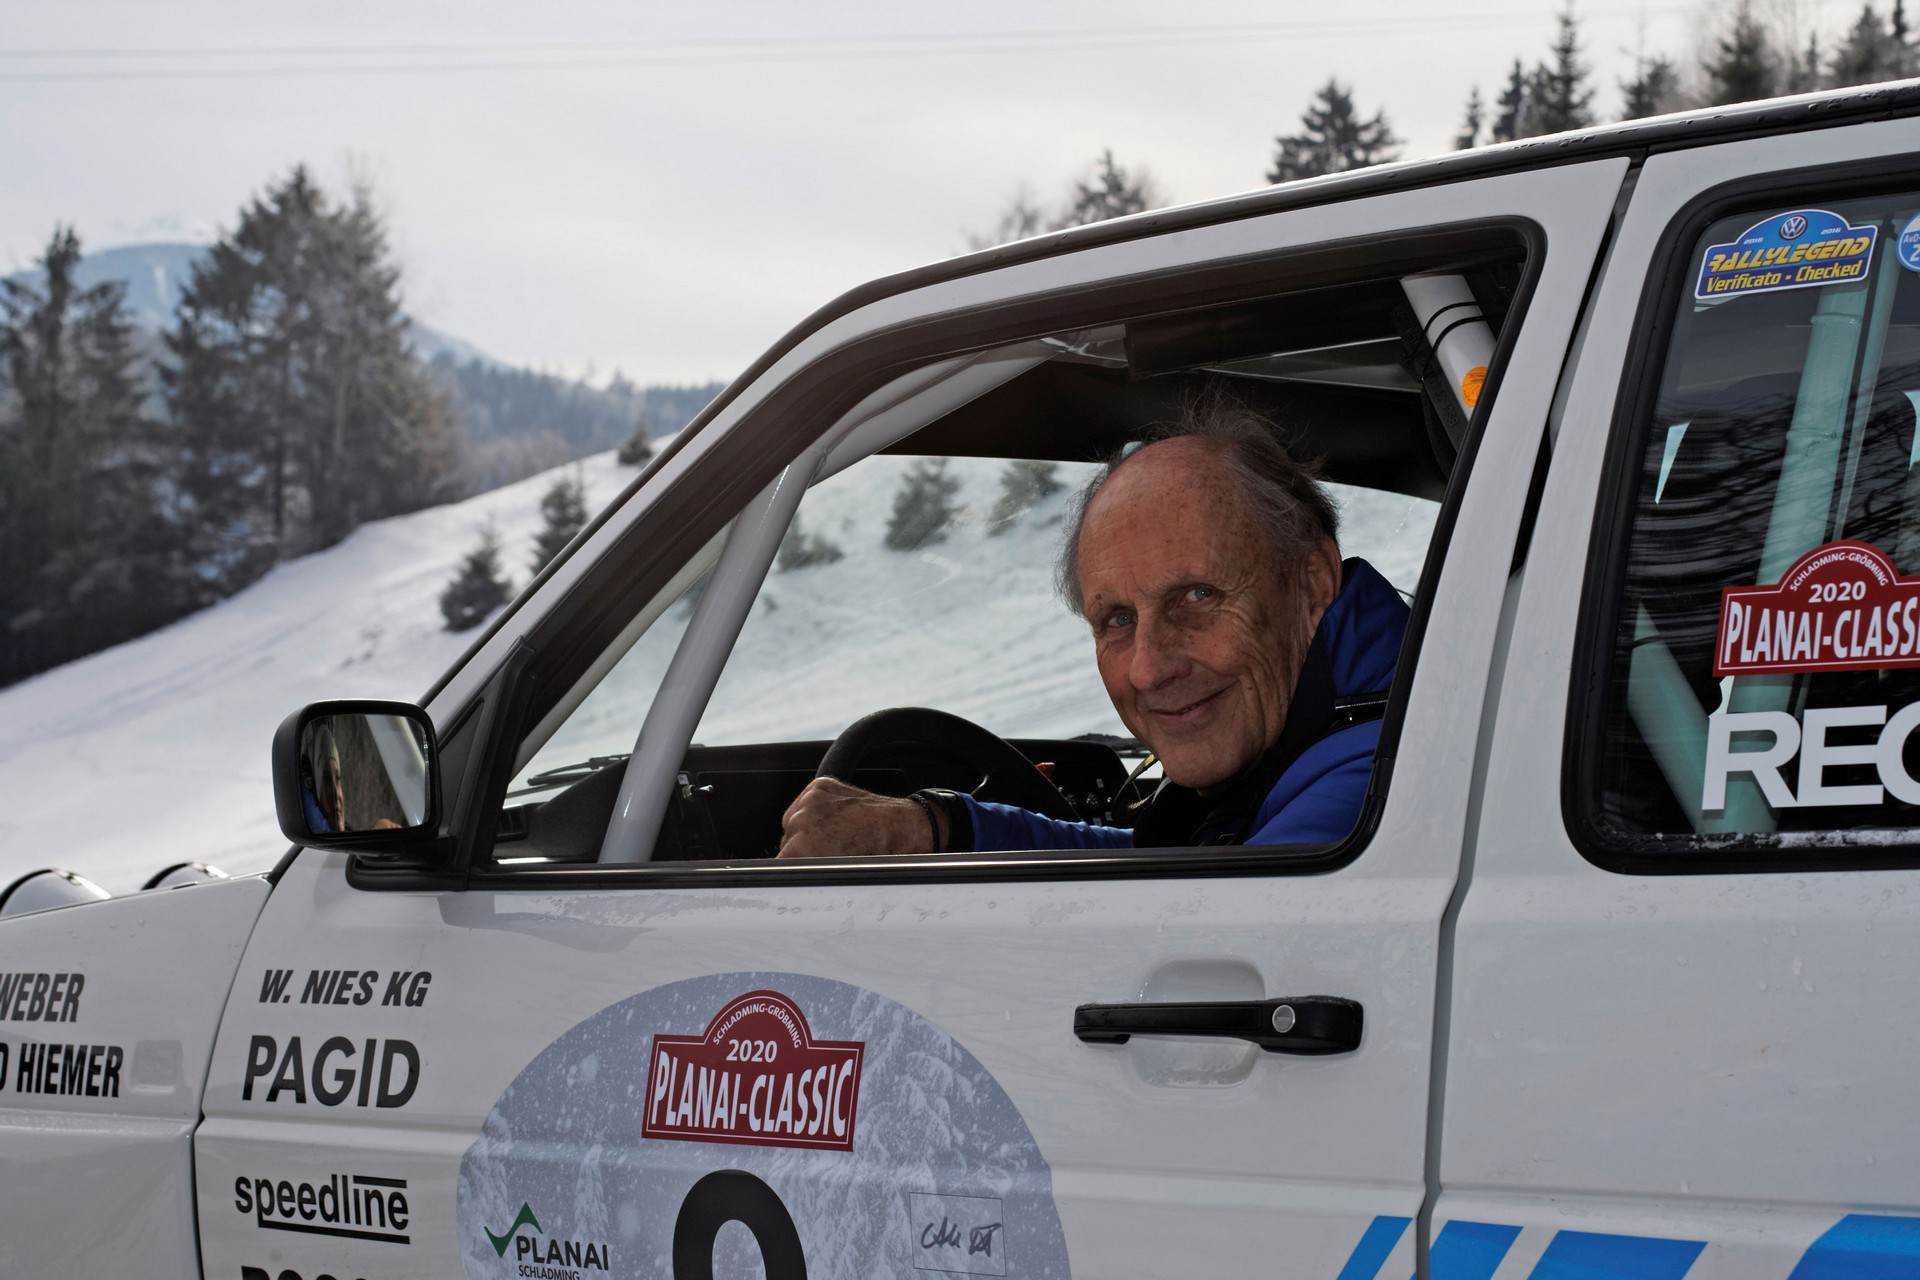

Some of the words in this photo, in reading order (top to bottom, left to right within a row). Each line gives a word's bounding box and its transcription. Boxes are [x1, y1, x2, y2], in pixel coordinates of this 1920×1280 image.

[1706, 271, 1780, 292] Verificato
[1795, 260, 1863, 283] Checked
[1789, 552, 1888, 592] SCHLADMING-GRÖBMING
[1808, 581, 1866, 603] 2020
[0, 973, 85, 1022] WEBER
[259, 969, 294, 1004] W.
[300, 970, 379, 1006] NIES
[381, 971, 432, 1007] KG
[713, 1003, 802, 1049] SCHLADMING-GRÖBMING
[17, 1043, 123, 1098] HIEMER
[726, 1039, 777, 1063] 2020
[242, 1035, 420, 1108] PAGID
[651, 1050, 854, 1137] PLANAI-CLASSIC
[235, 1174, 409, 1231] speedline
[516, 1235, 609, 1271] PLANAI
[518, 1264, 580, 1280] SCHLADMING
